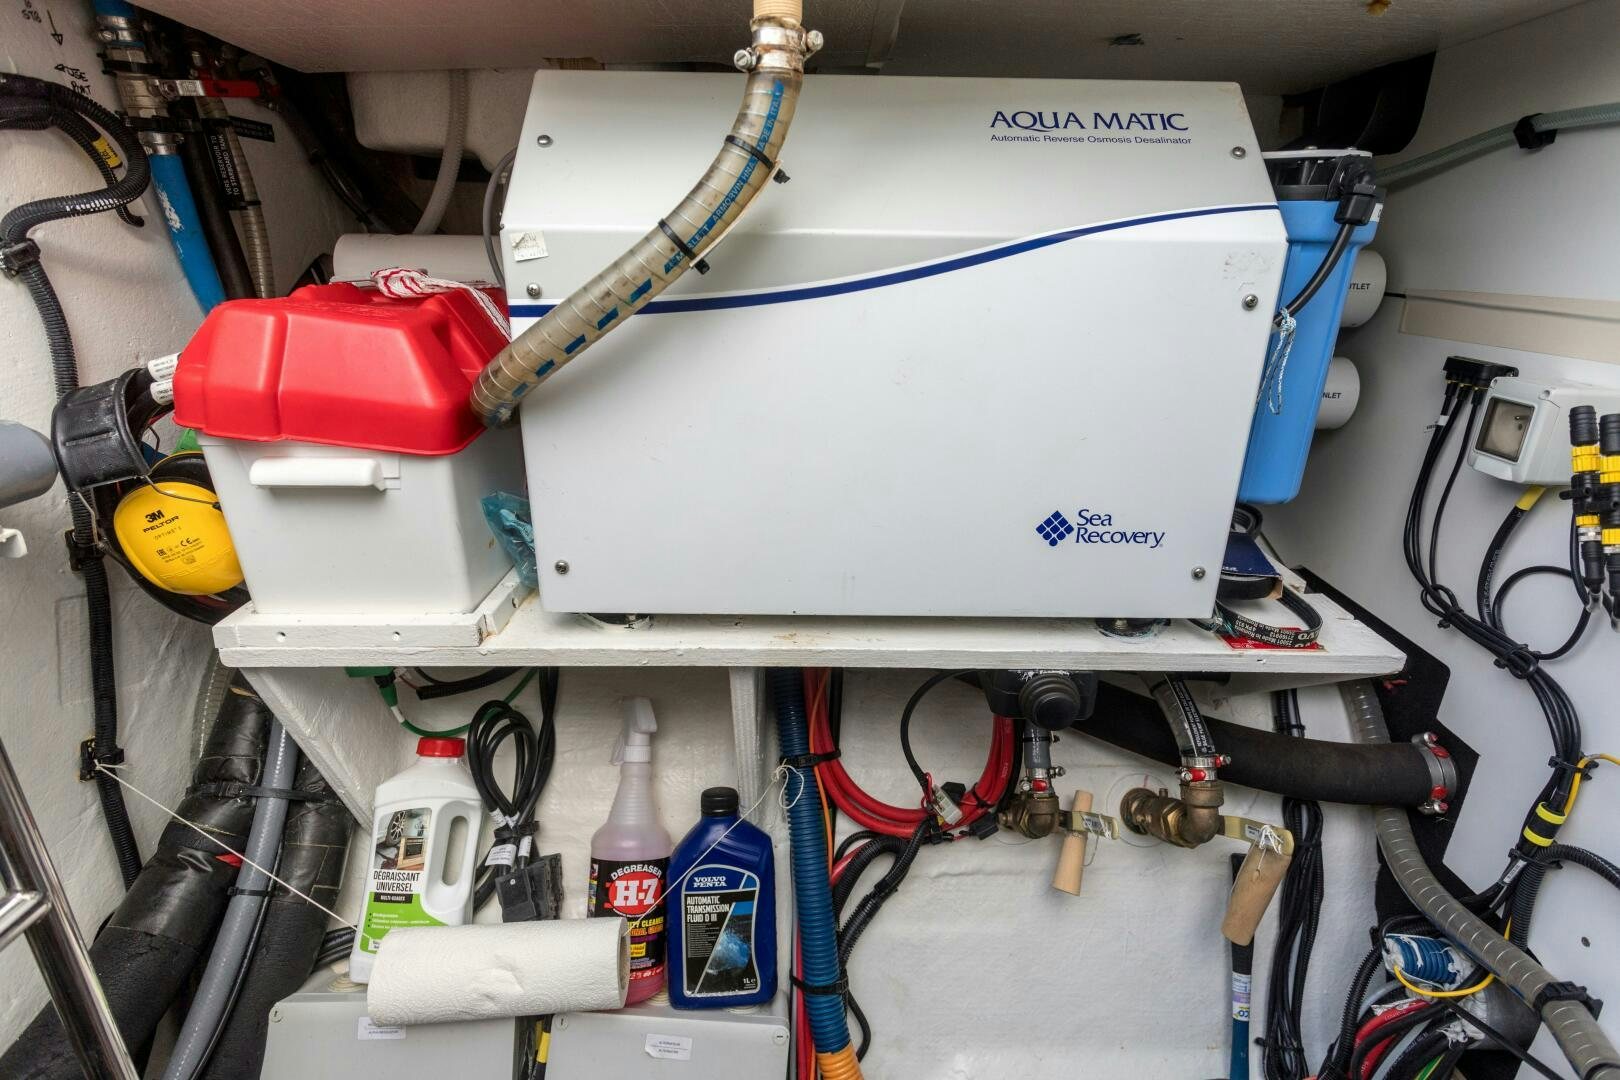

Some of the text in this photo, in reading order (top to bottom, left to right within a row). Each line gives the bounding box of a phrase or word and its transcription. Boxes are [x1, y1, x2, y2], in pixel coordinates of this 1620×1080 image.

[989, 110, 1190, 133] AQUA MATIC
[990, 134, 1192, 145] Automatic Reverse Osmosis Desalinator
[222, 151, 238, 187] STARBOARD
[143, 515, 180, 533] PELTOR
[145, 509, 165, 524] 3M
[1076, 508, 1113, 527] Sea
[1075, 527, 1166, 549] Recovery
[610, 864, 663, 880] DEGREASER
[376, 881, 413, 893] UNIVERSEL
[613, 879, 658, 907] H-7
[686, 896, 720, 905] AUTOMATIC
[686, 903, 731, 914] TRANSMISSION
[686, 914, 718, 923] FLUID D III
